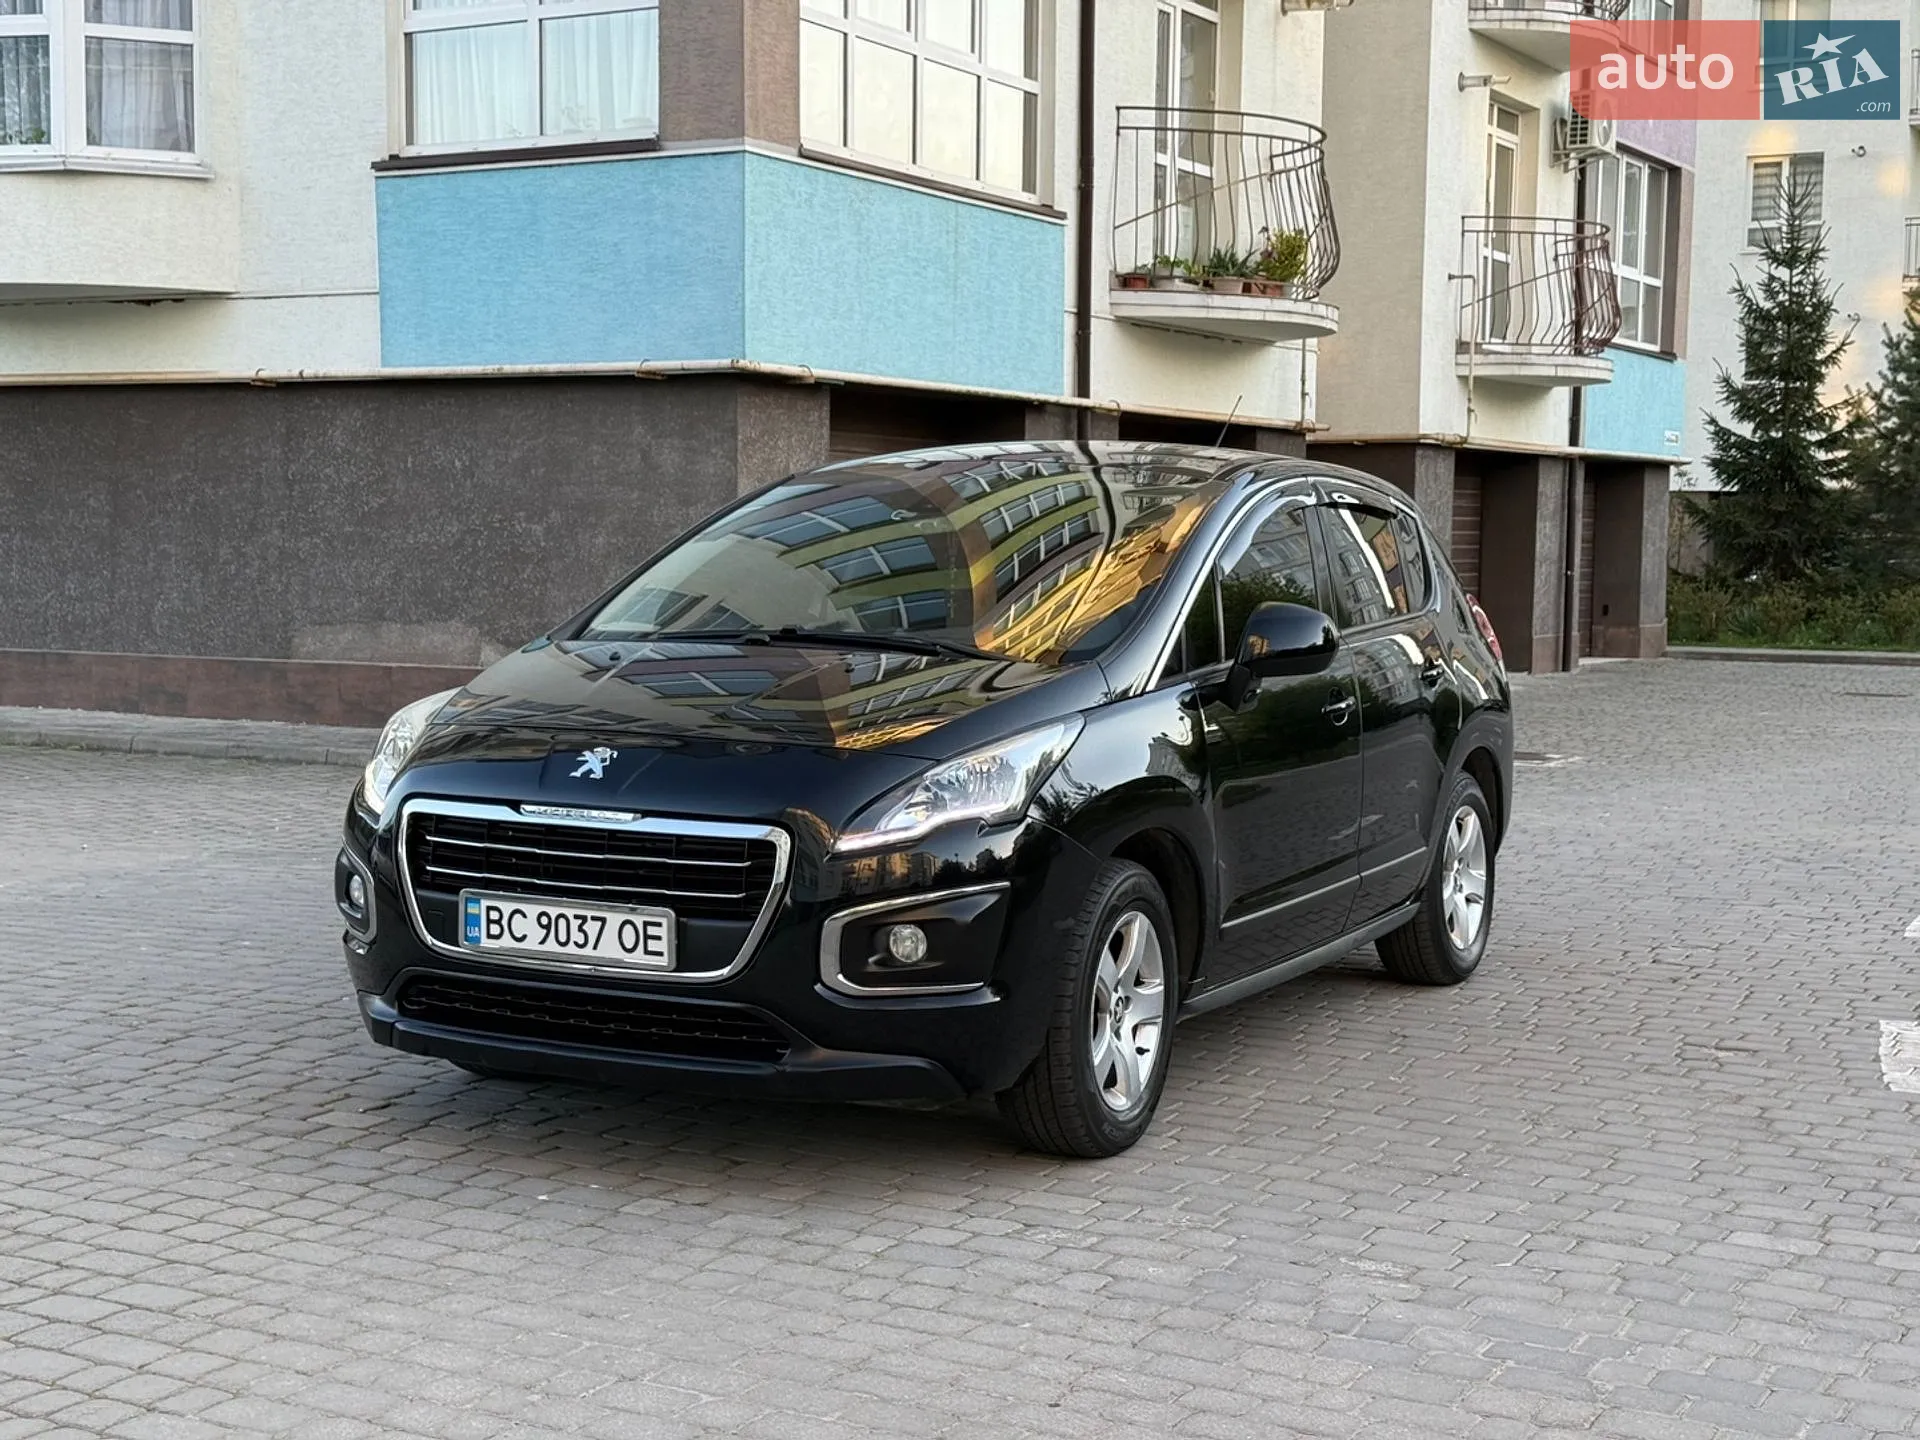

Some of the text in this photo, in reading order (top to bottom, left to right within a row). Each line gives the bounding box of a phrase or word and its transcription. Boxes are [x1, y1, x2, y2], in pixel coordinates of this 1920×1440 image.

[467, 925, 480, 938] UA
[486, 905, 665, 957] BC 9037 OE
